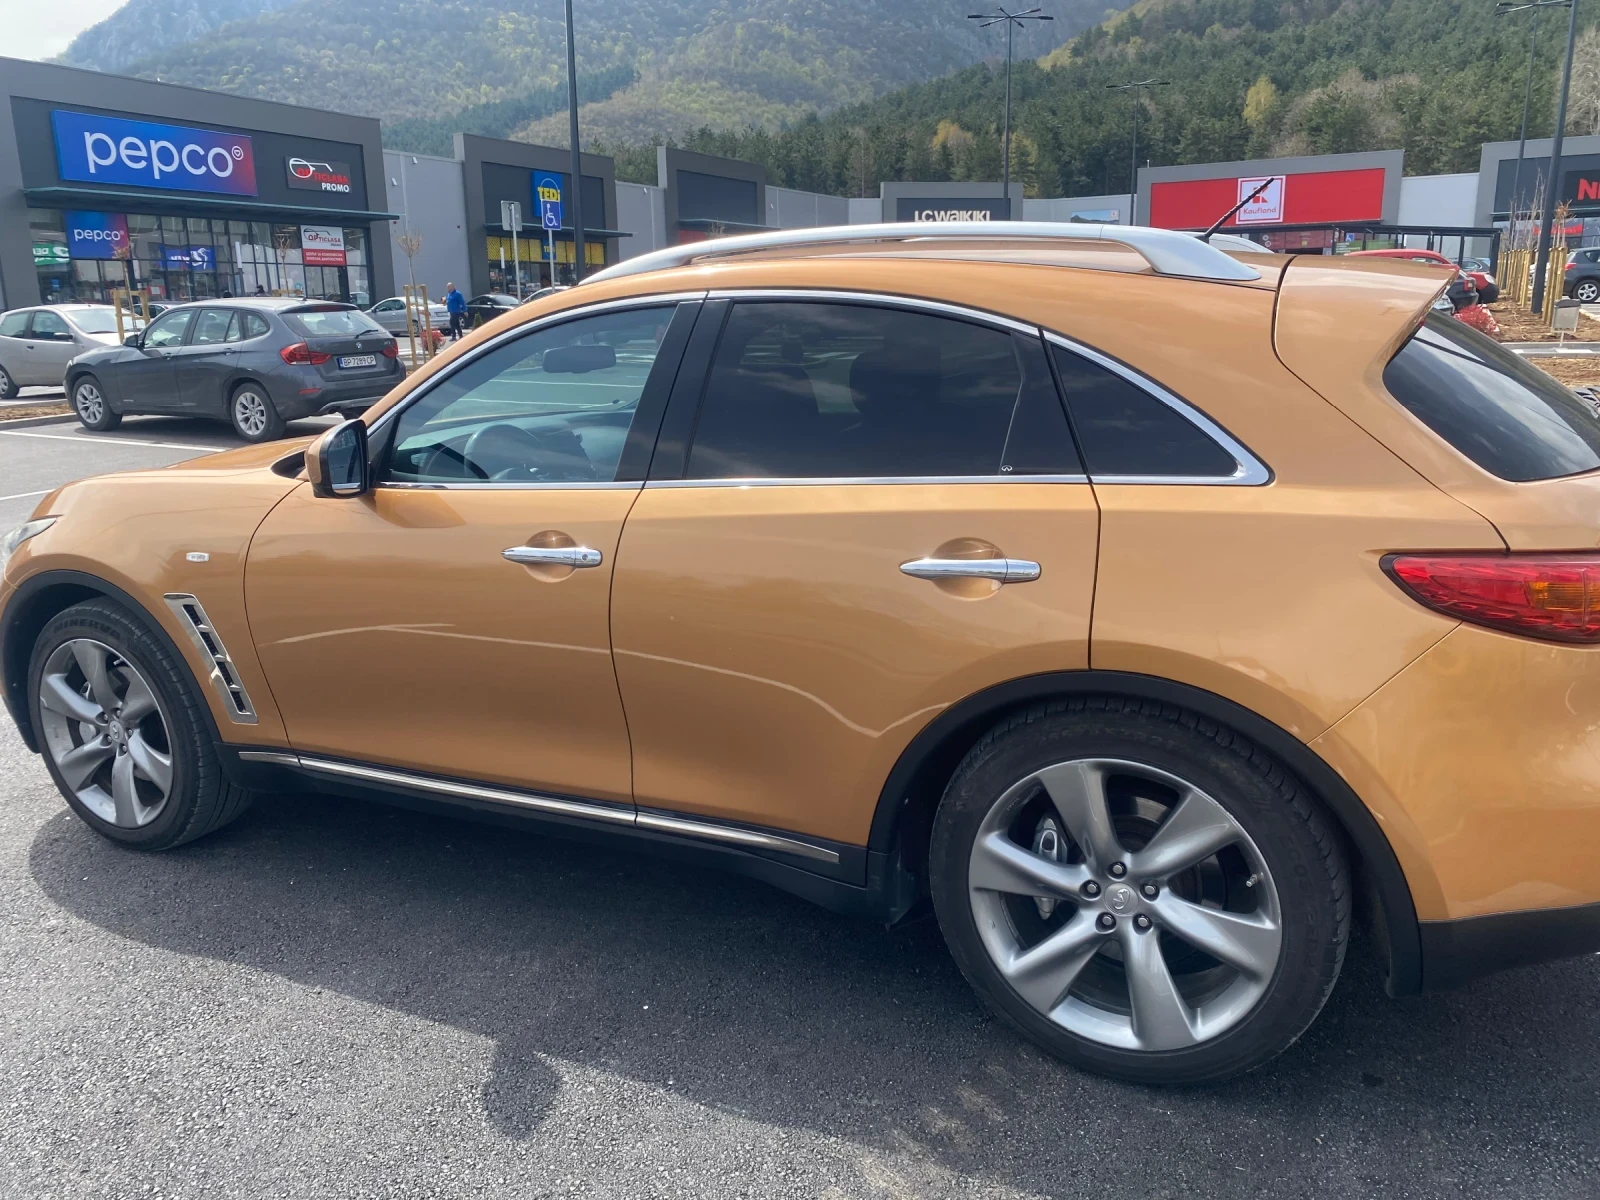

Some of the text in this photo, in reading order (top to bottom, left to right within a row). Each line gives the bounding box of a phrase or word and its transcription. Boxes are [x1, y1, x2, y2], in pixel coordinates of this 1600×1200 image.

[84, 131, 233, 179] pepco
[321, 182, 350, 192] PROMO
[1577, 178, 1600, 200] N
[1243, 207, 1277, 215] Kaufland
[74, 229, 120, 242] pepco
[54, 618, 121, 640] MINERVA
